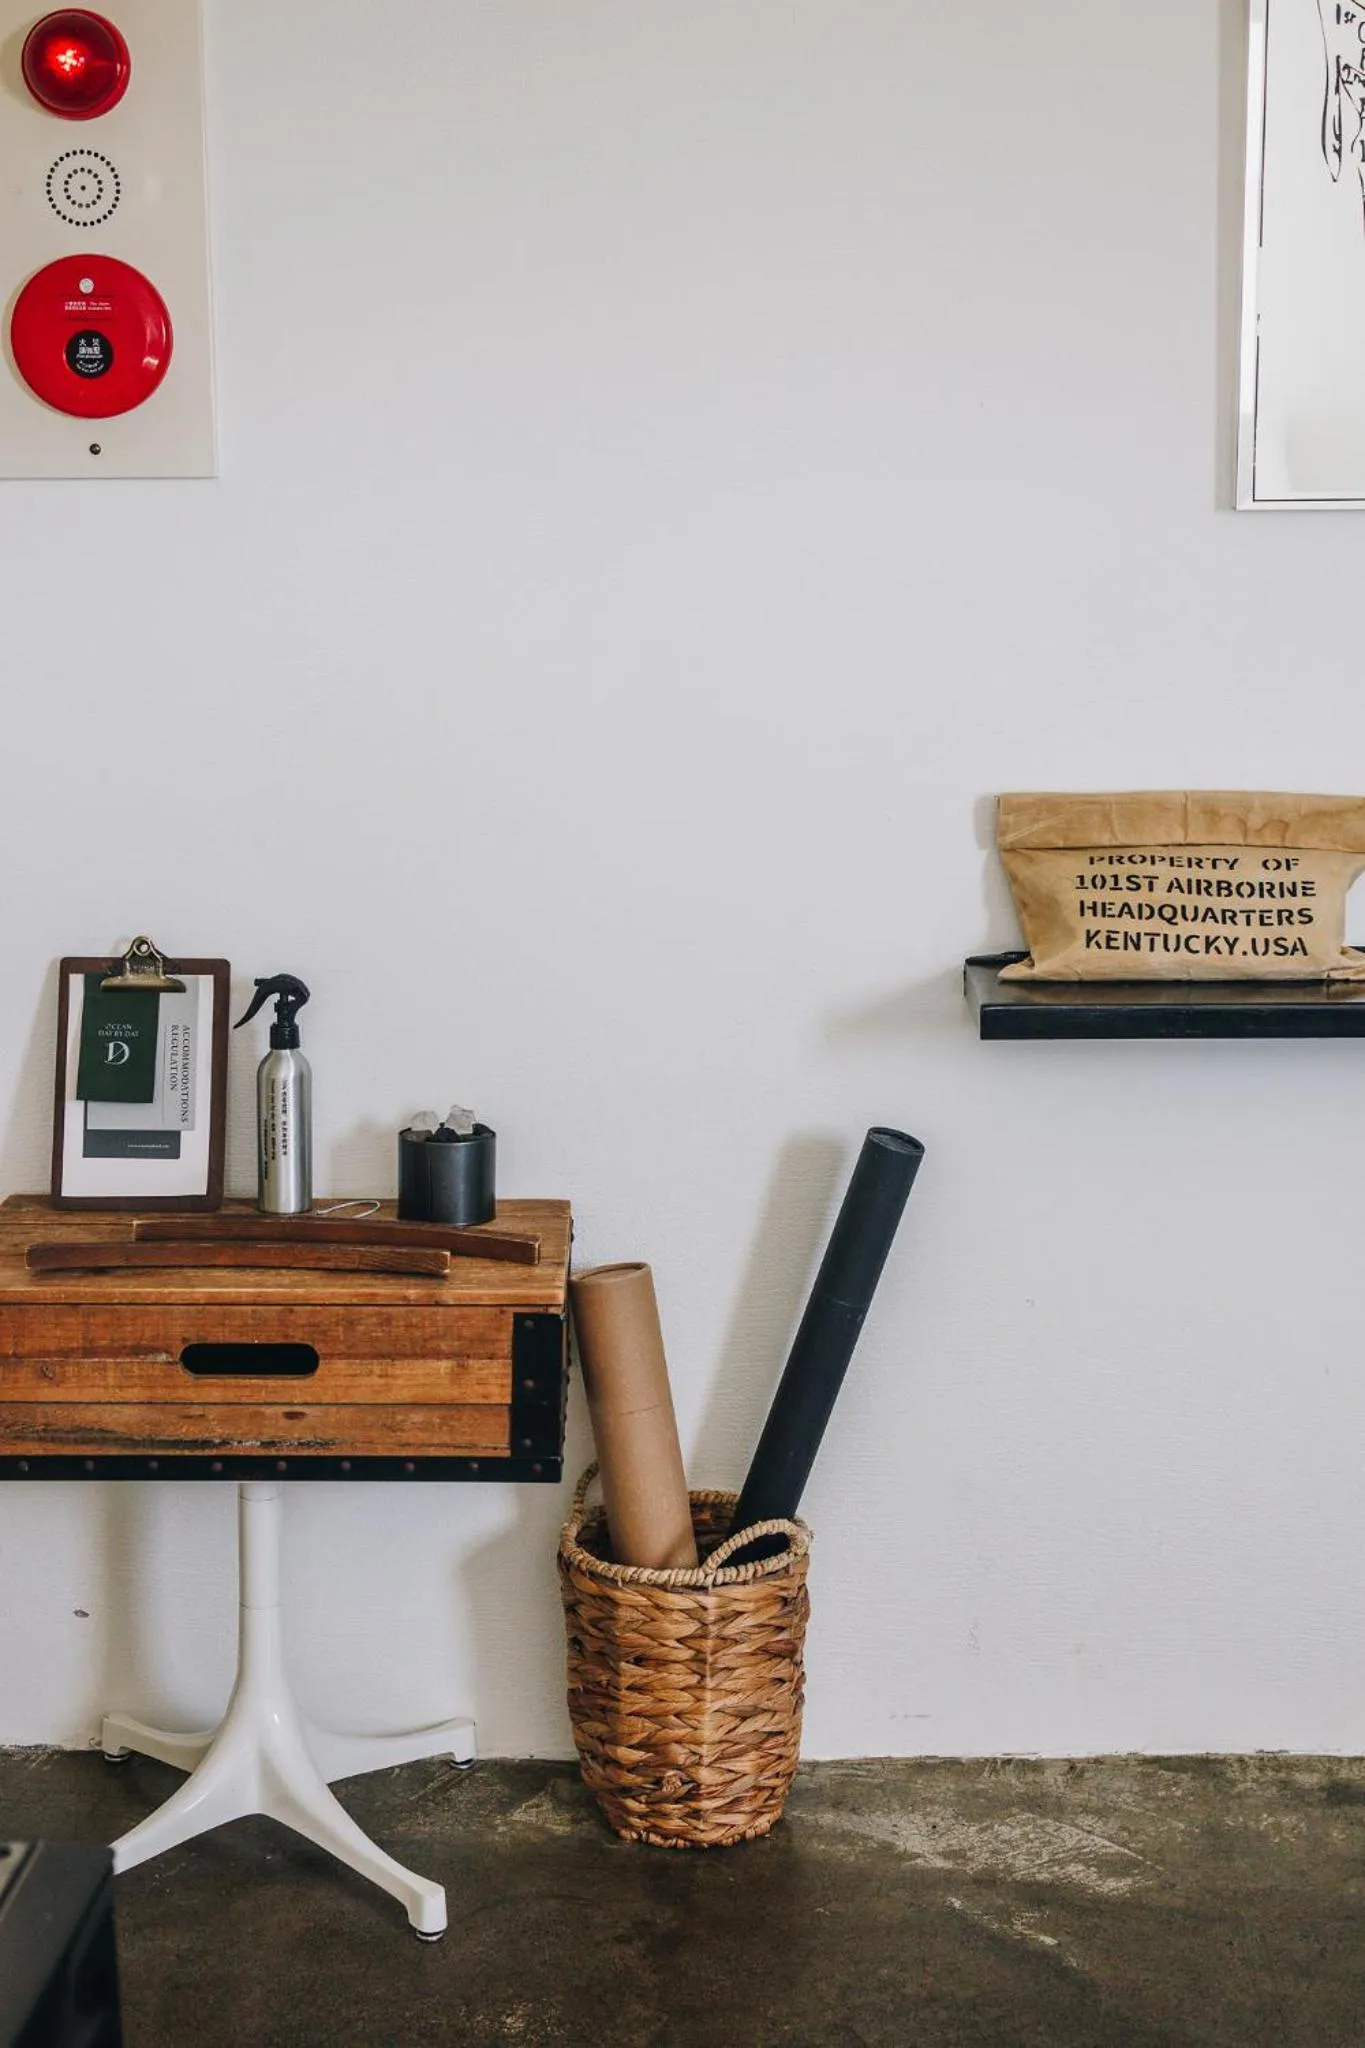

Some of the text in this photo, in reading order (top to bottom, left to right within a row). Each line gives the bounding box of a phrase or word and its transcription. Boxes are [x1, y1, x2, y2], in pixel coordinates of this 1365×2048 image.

[1089, 854, 1299, 871] PROPERTY OF
[1075, 874, 1316, 899] 101ST AIRBORNE
[1079, 900, 1314, 927] HEADQUARTERS
[1085, 929, 1309, 957] KENTUCKY.USA
[169, 1024, 180, 1091] REGULATION
[180, 1024, 191, 1123] ACCOMMODATIONS
